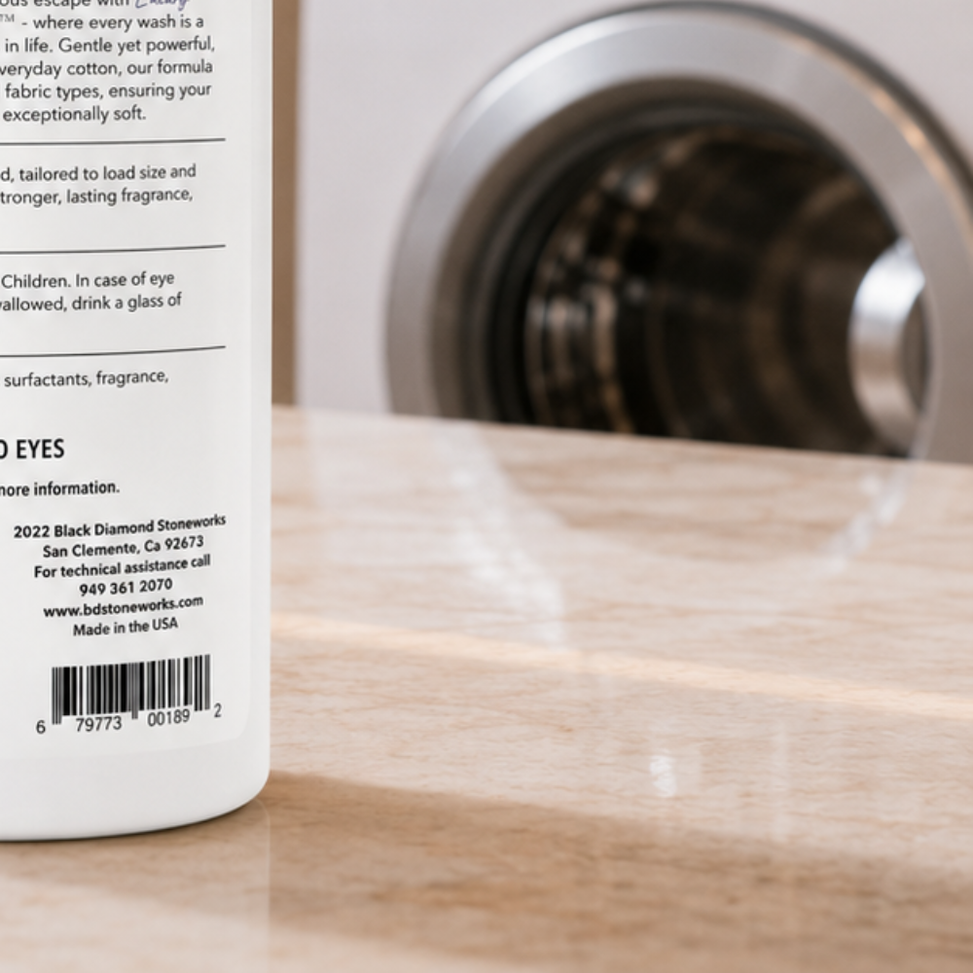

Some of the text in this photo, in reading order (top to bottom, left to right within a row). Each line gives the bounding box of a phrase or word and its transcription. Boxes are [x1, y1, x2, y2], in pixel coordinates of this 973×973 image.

[5, 38, 19, 53] in
[25, 37, 53, 53] life.
[58, 37, 113, 53] Gentle
[117, 39, 141, 56] yet
[146, 35, 215, 55] powerful,
[2, 105, 110, 125] exceptionally
[113, 104, 146, 121] soft.
[19, 166, 78, 182] tailored
[83, 168, 99, 181] to
[103, 165, 136, 181] load
[139, 165, 166, 180] size
[170, 163, 196, 178] and
[66, 189, 117, 207] lasting
[121, 187, 193, 206] fragrance,
[1, 274, 71, 289] Children.
[76, 274, 90, 287] In
[94, 275, 127, 288] case
[131, 270, 147, 286] of
[150, 274, 175, 288] eye
[4, 372, 92, 388] surfactants,
[96, 370, 168, 388] fragrance,
[16, 438, 65, 460] EYES
[34, 480, 120, 496] information.
[14, 513, 226, 539] 2022 Black Diamond Stoneworks
[43, 534, 204, 558] San Clemente, Ca 92673
[34, 553, 211, 578] For technical assistance call
[79, 577, 173, 597] 949 361 2070
[43, 596, 203, 617] www.bdstoneworks.com
[73, 616, 178, 637] Made in the USA
[36, 703, 222, 734] 6 79773 00189 2
